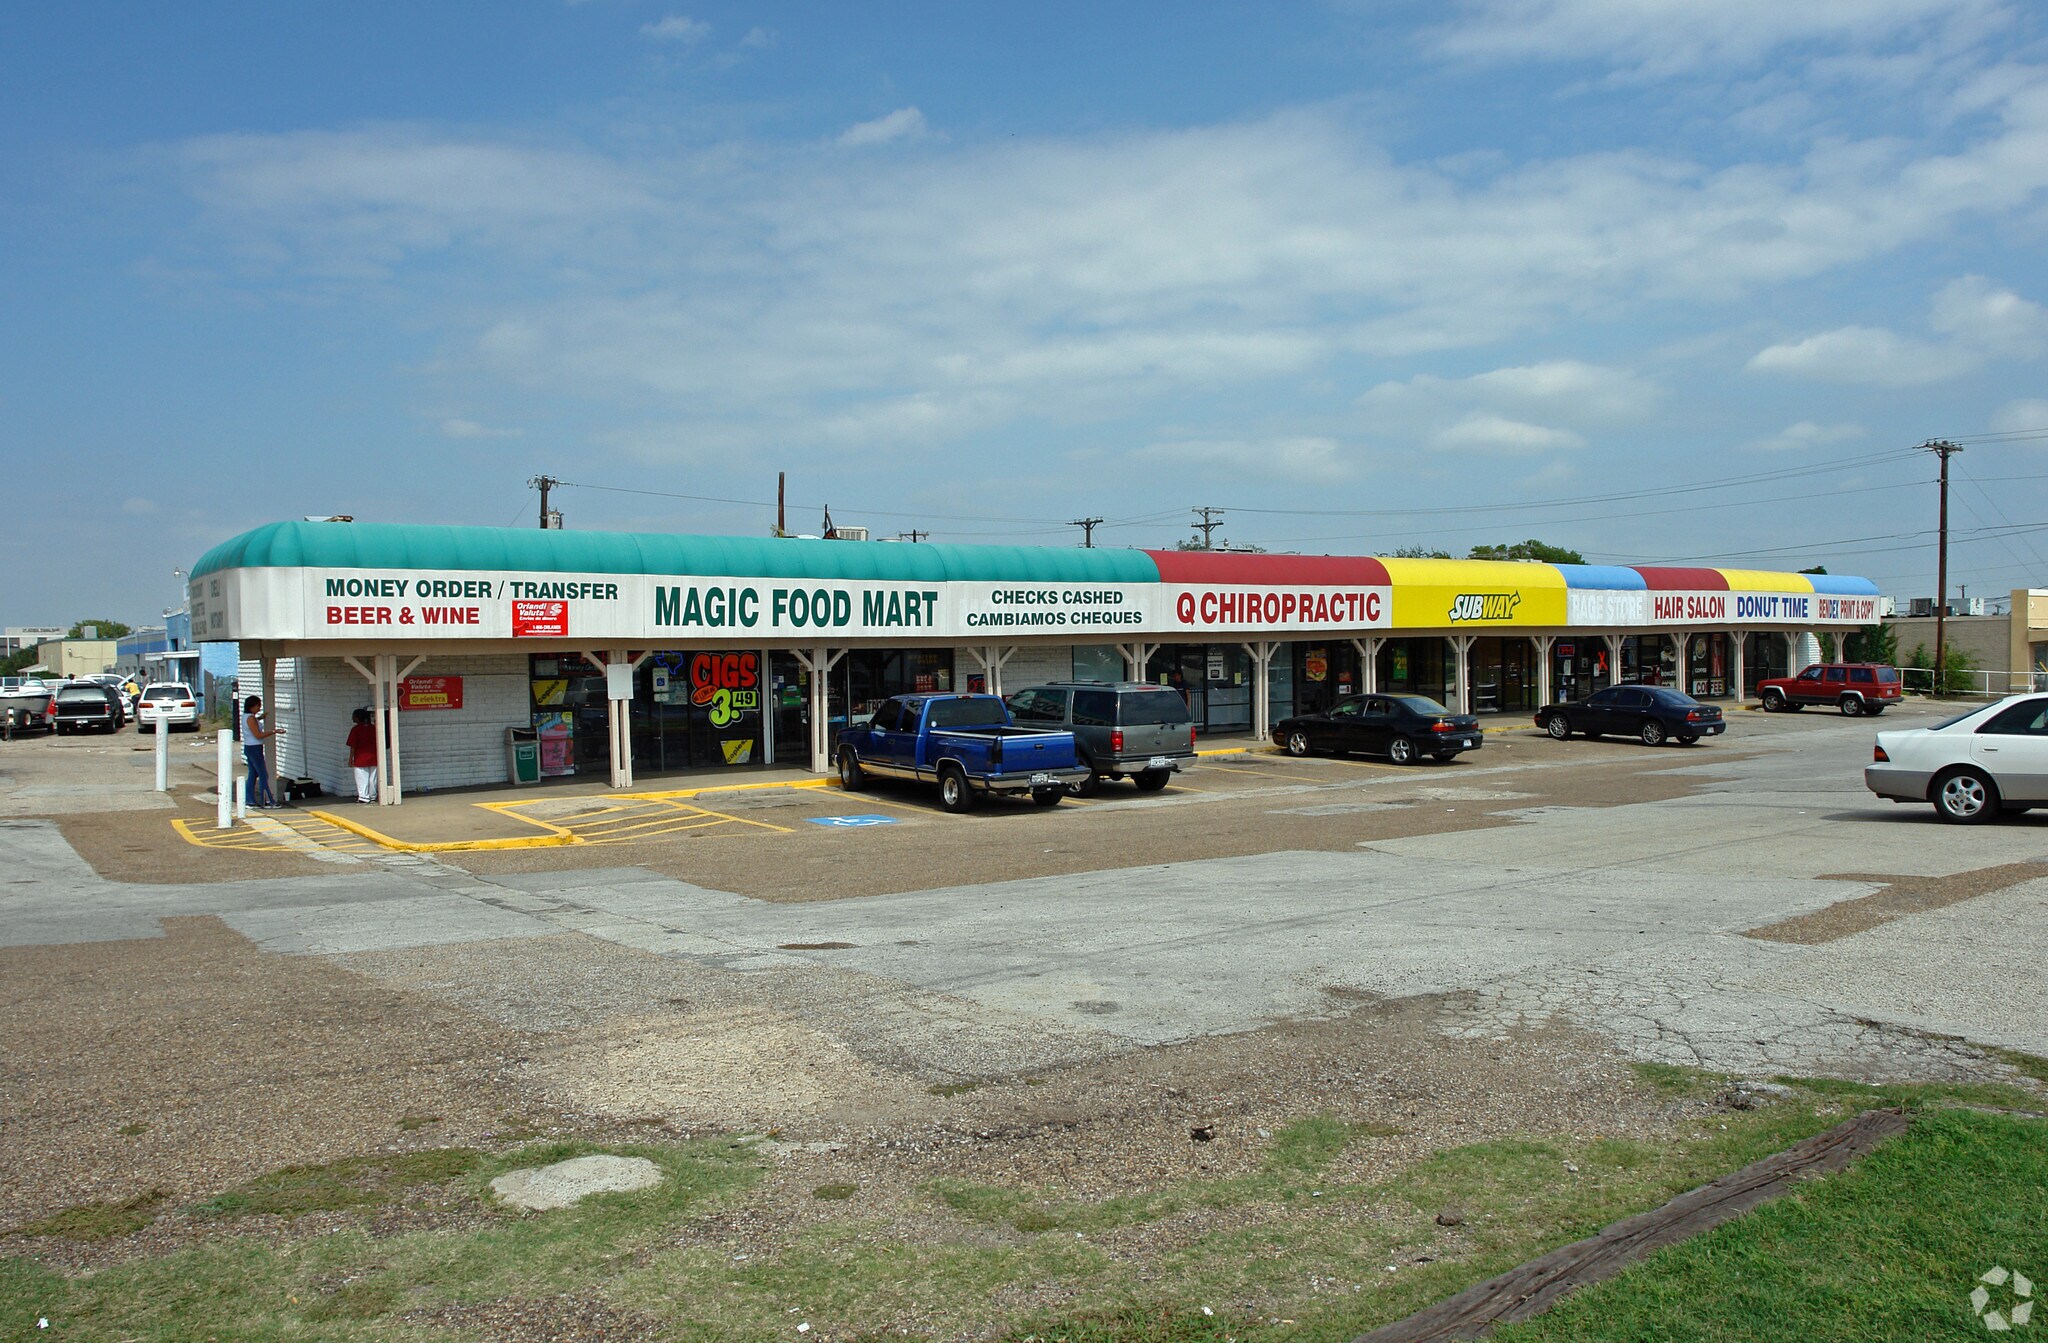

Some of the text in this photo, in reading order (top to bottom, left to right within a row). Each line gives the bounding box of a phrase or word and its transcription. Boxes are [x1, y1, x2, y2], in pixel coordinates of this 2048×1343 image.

[326, 579, 409, 597] MONEY
[416, 580, 492, 598] ORDER
[510, 582, 618, 600] TRANSFER
[991, 590, 1123, 604] CHECKS CASHED
[327, 606, 480, 625] BEER & WINE
[655, 586, 938, 628] MAGIC FOOD MART
[1448, 591, 1520, 623] SUBWAY
[1608, 595, 1643, 620] STORE
[1654, 596, 1725, 619] HAIR SALON
[1737, 596, 1808, 618] DONUT TIME
[1841, 600, 1855, 619] PRINT
[1856, 600, 1860, 619] &
[1861, 600, 1875, 619] COPY
[966, 611, 1142, 626] CAMBIAMOS CHEQUES
[693, 653, 756, 689] CIGS
[420, 695, 446, 703] elektra
